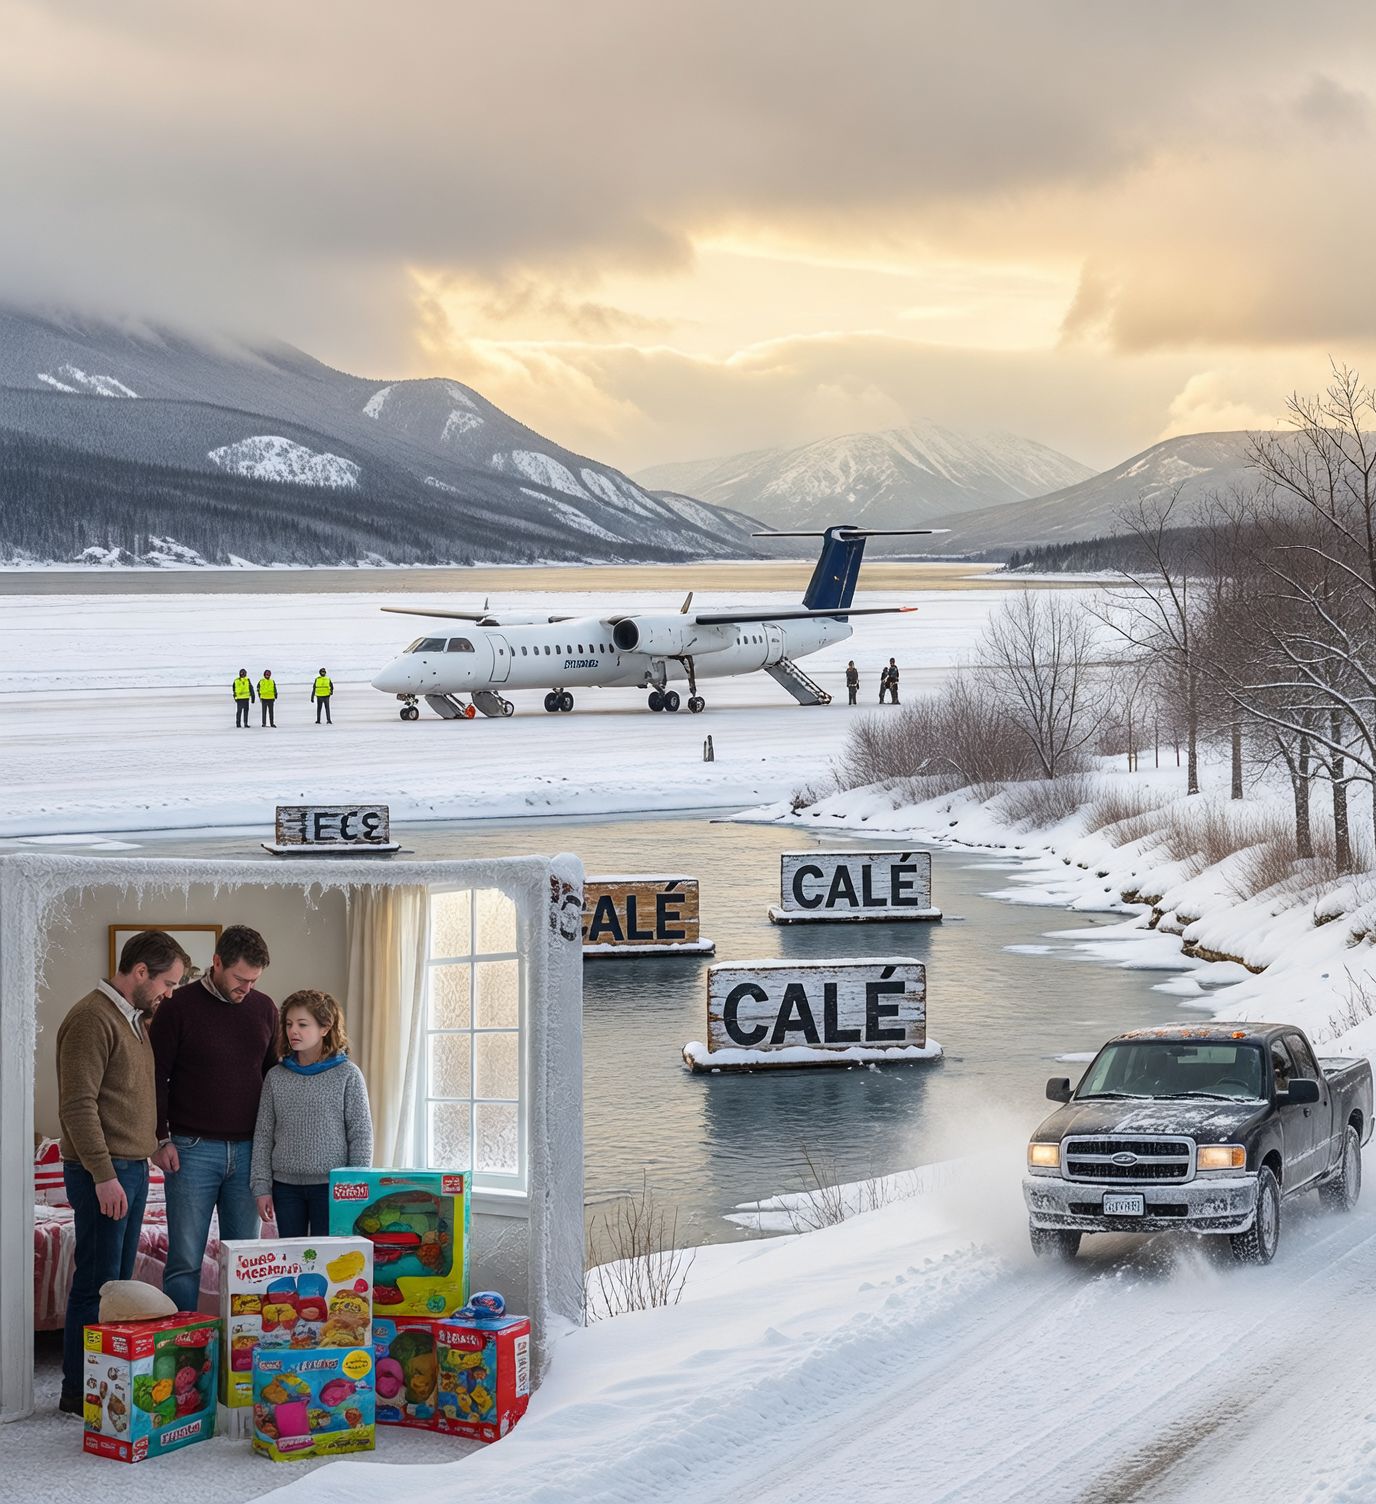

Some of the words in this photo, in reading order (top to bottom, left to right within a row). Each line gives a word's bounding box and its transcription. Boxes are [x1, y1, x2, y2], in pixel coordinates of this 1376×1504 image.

[581, 880, 686, 942] ALÉ
[792, 853, 919, 909] CALÉ
[723, 966, 906, 1046] CALÉ
